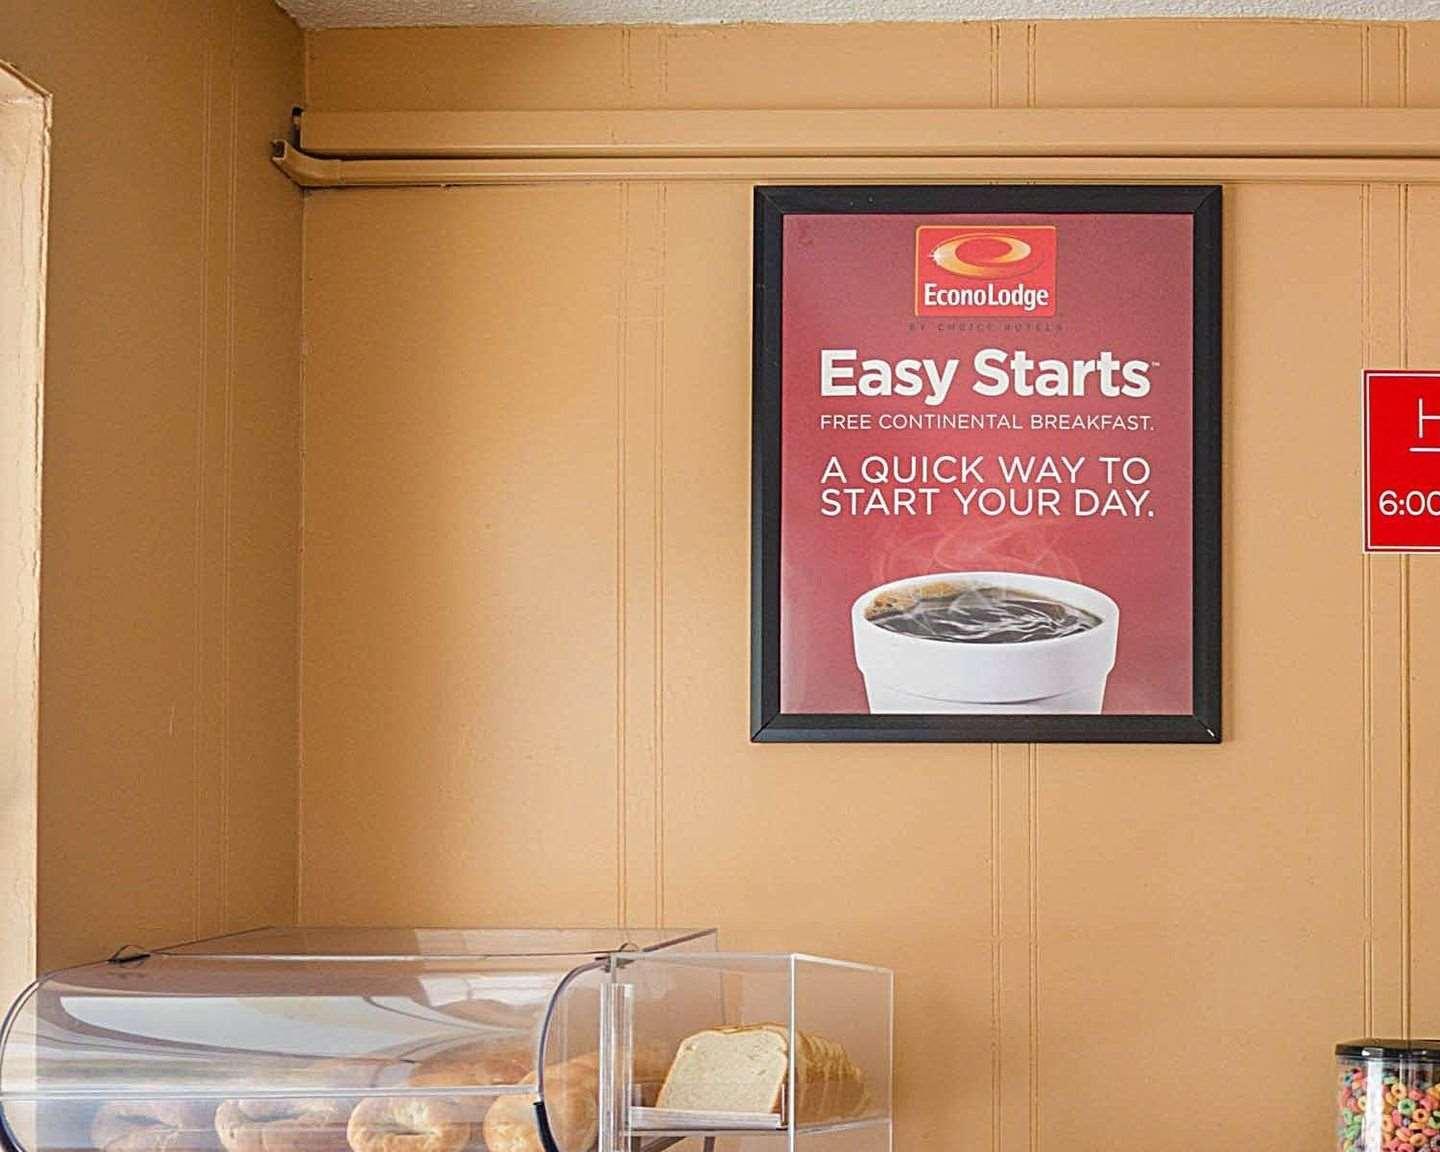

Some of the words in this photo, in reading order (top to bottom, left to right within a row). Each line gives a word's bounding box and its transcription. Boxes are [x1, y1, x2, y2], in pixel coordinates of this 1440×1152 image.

[923, 282, 1050, 312] EconoLodge
[819, 348, 960, 407] Easy
[819, 413, 872, 431] FREE
[878, 413, 1024, 431] CONTINENTAL
[1030, 413, 1155, 432] BREAKFAST.
[819, 455, 848, 485] A
[860, 455, 985, 485] QUICK
[997, 455, 1087, 485] WAY
[1097, 455, 1152, 486] TO
[819, 487, 941, 517] START
[952, 487, 1062, 518] YOUR
[1074, 488, 1155, 519] DAY.
